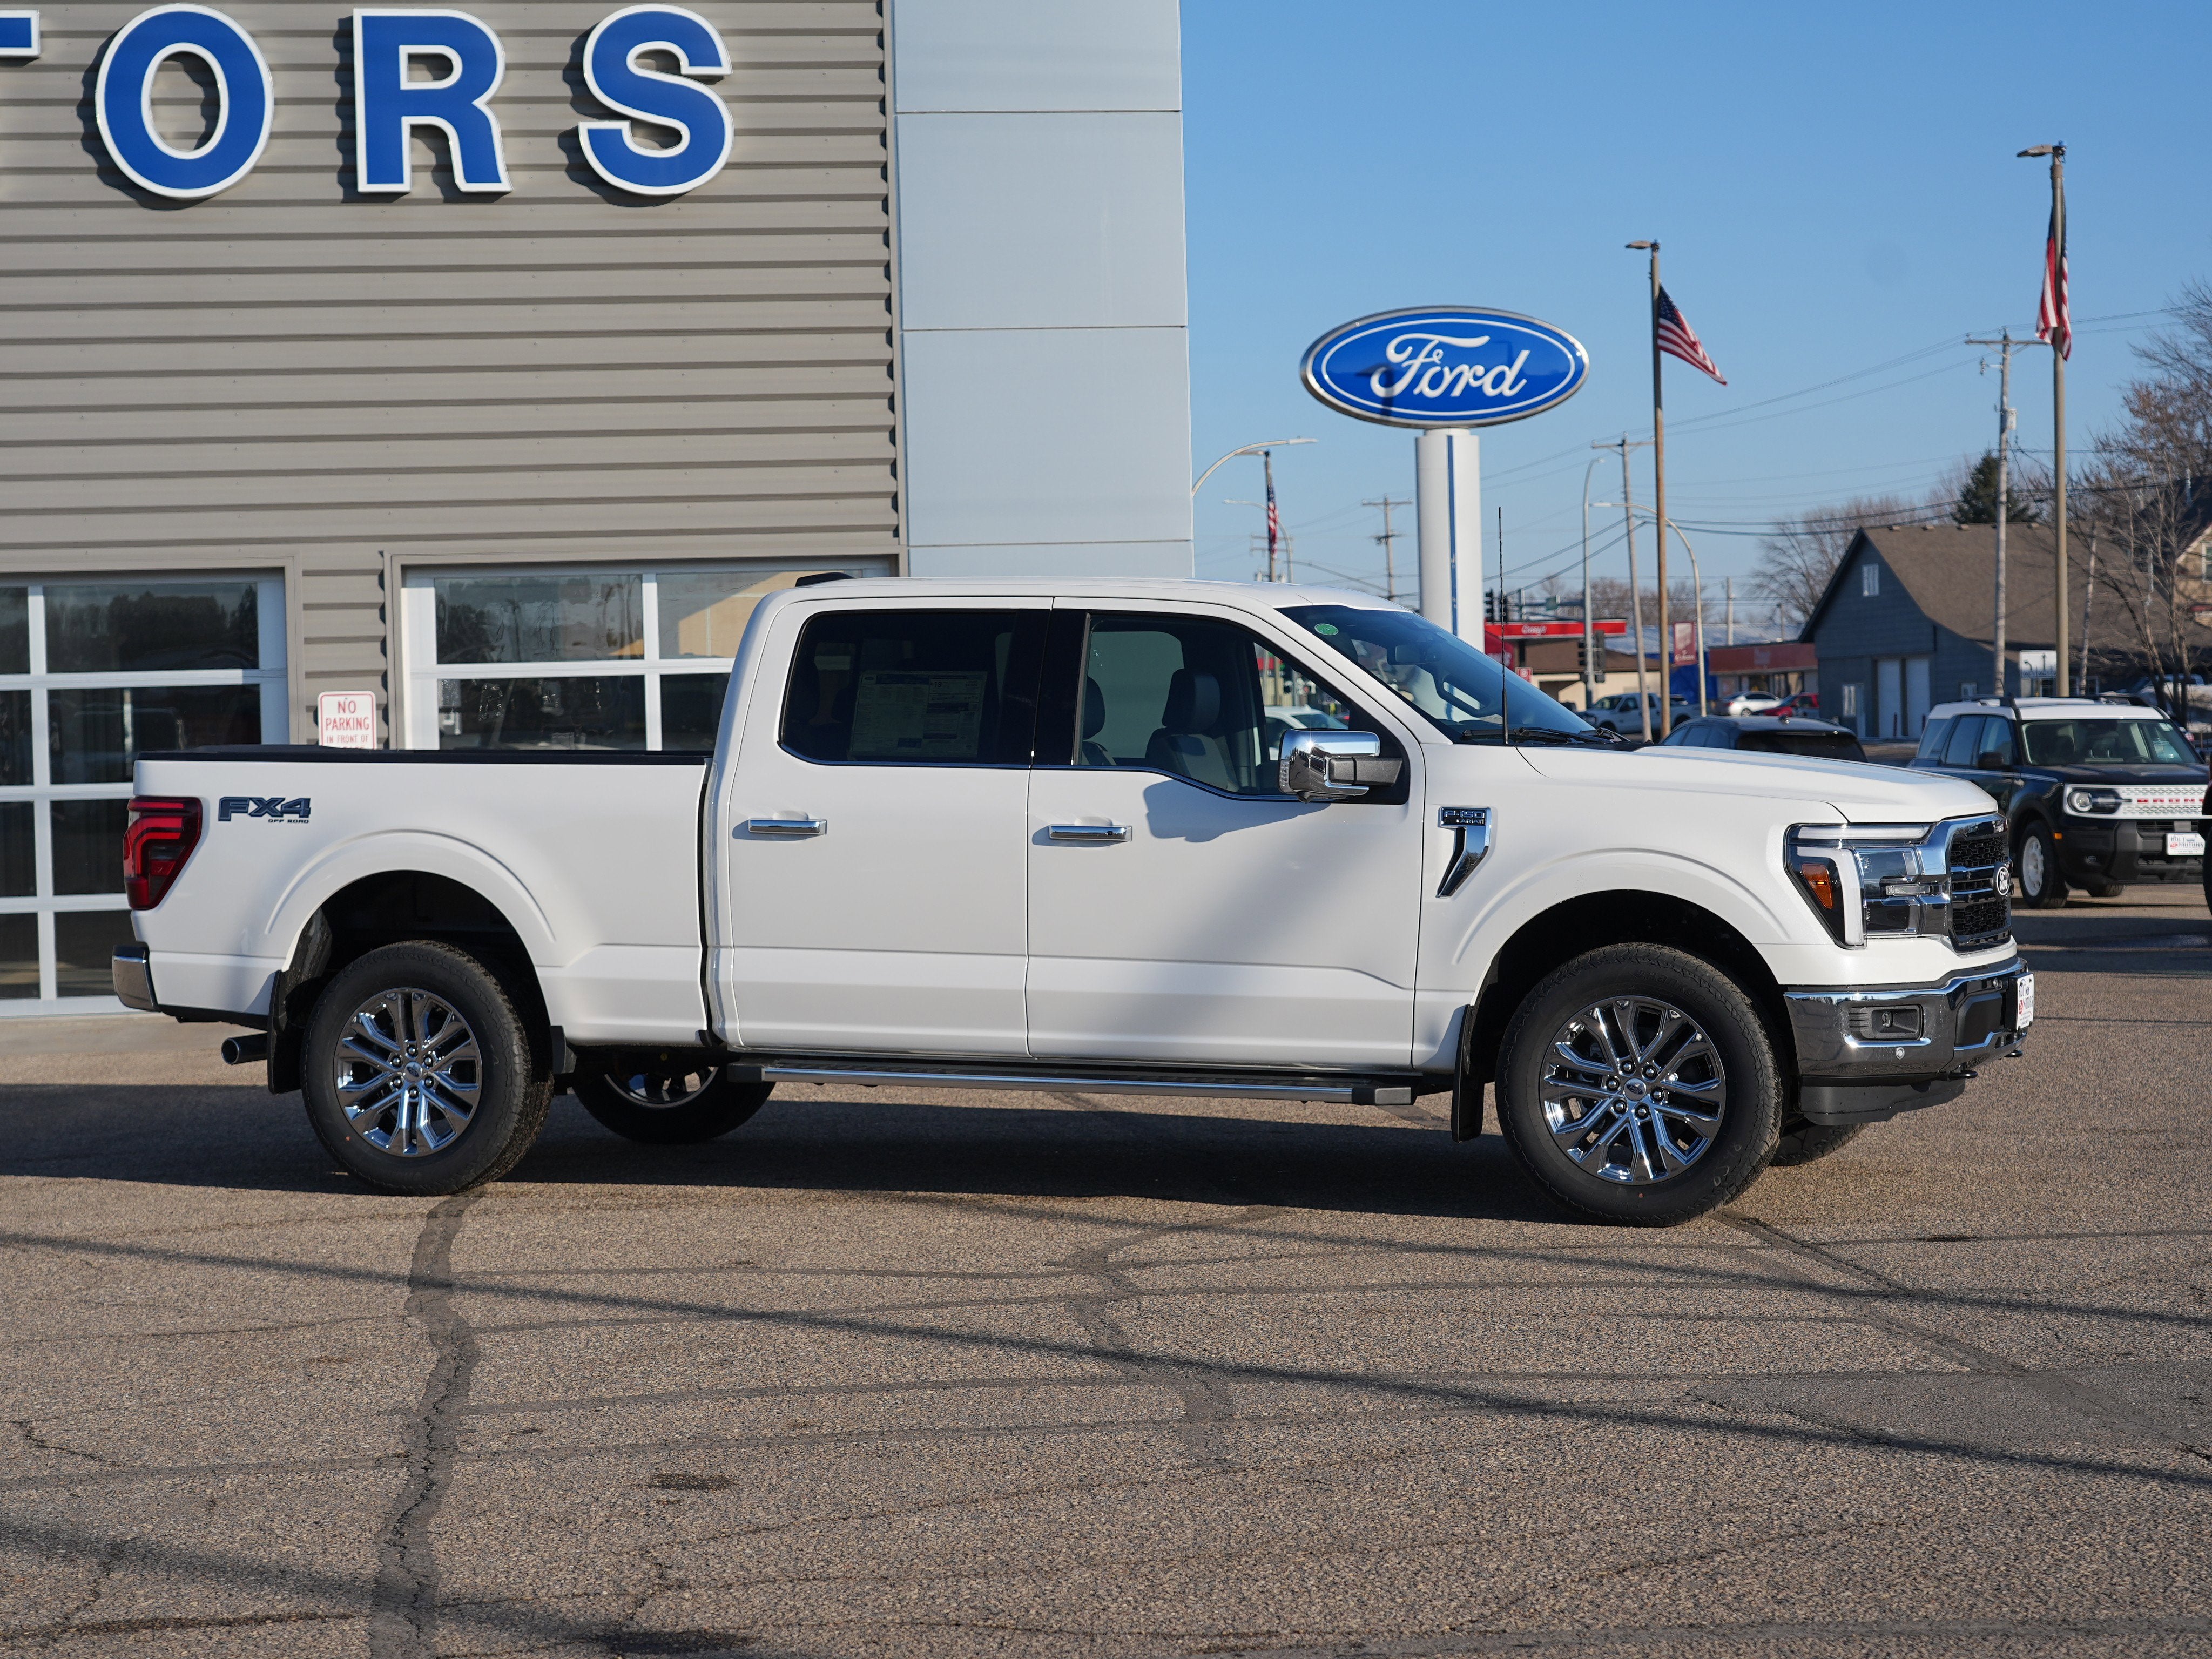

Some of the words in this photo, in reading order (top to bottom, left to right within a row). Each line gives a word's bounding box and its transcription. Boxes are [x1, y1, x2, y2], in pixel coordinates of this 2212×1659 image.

[0, 3, 734, 198] ORS
[1370, 333, 1530, 398] Ford
[338, 700, 356, 713] NO
[325, 717, 370, 731] PARKING
[327, 735, 334, 743] IN
[337, 734, 357, 743] FRONT
[361, 734, 369, 743] OF
[218, 797, 311, 821] FX4
[1444, 810, 1485, 819] F-150
[1999, 870, 2008, 891] Ford
